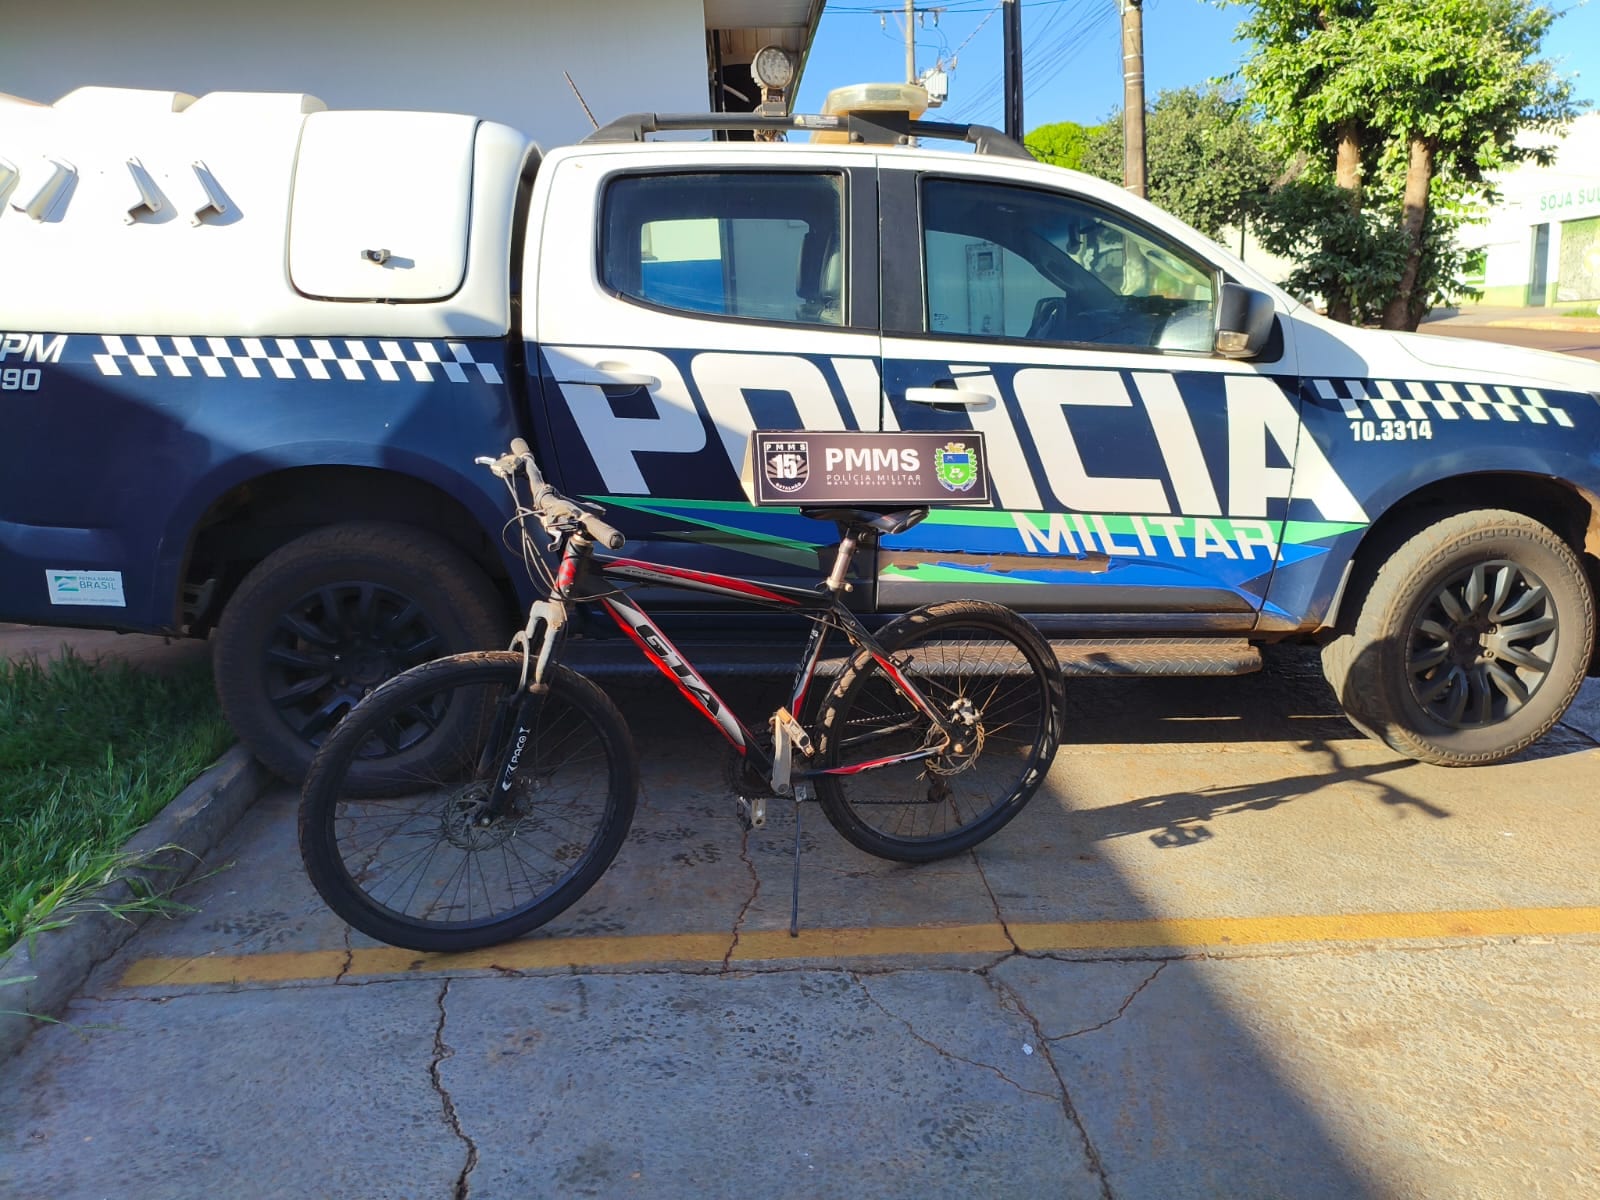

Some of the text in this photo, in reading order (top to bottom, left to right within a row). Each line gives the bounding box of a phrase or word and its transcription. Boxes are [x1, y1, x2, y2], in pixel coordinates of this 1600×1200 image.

[1540, 191, 1572, 211] SOJA
[0, 333, 68, 363] PM
[1349, 420, 1433, 441] 10.3314
[825, 447, 920, 472] PMMS
[826, 473, 871, 481] POLÍCIA
[1011, 512, 1284, 561] MILITAR
[80, 580, 116, 590] BRASIL
[635, 624, 720, 718] GTA
